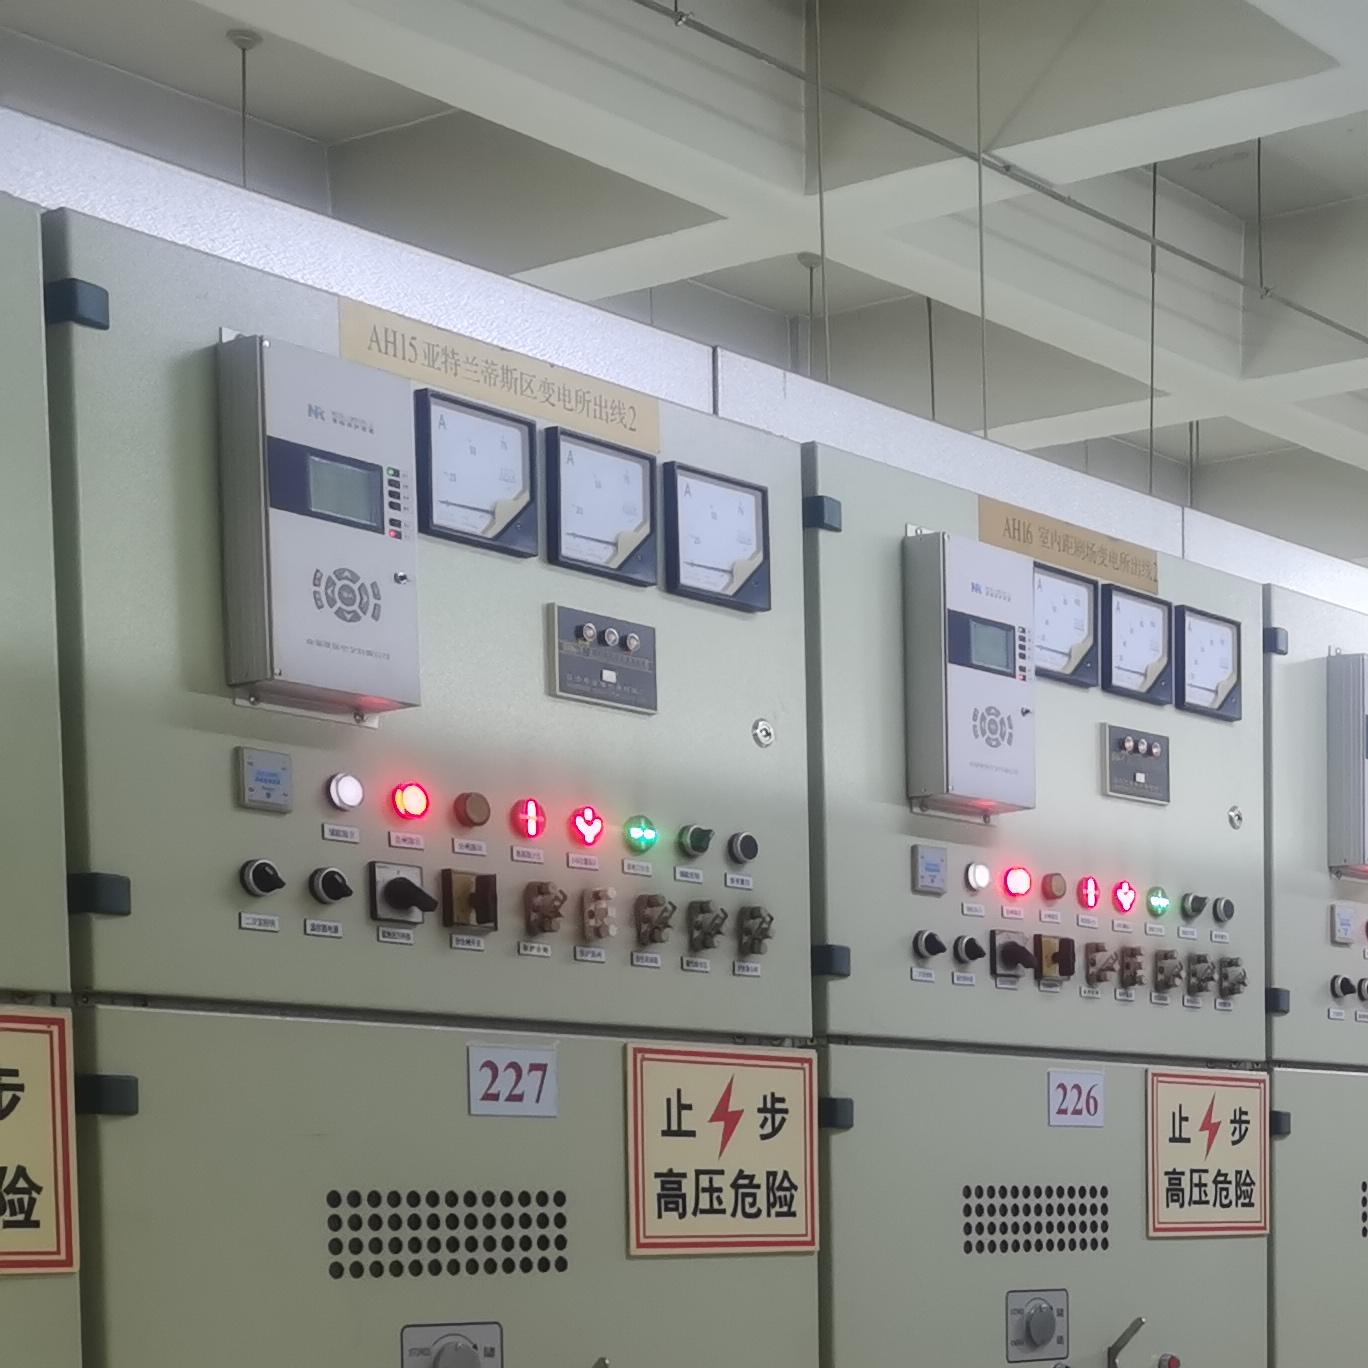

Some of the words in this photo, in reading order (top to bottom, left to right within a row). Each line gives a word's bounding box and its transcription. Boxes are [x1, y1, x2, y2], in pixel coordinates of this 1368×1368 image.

[366, 324, 418, 364] AH15
[478, 1060, 549, 1105] 227
[1055, 1082, 1099, 1117] 226
[653, 1168, 800, 1221] 高压危险
[1164, 1168, 1257, 1210] 高压危险
